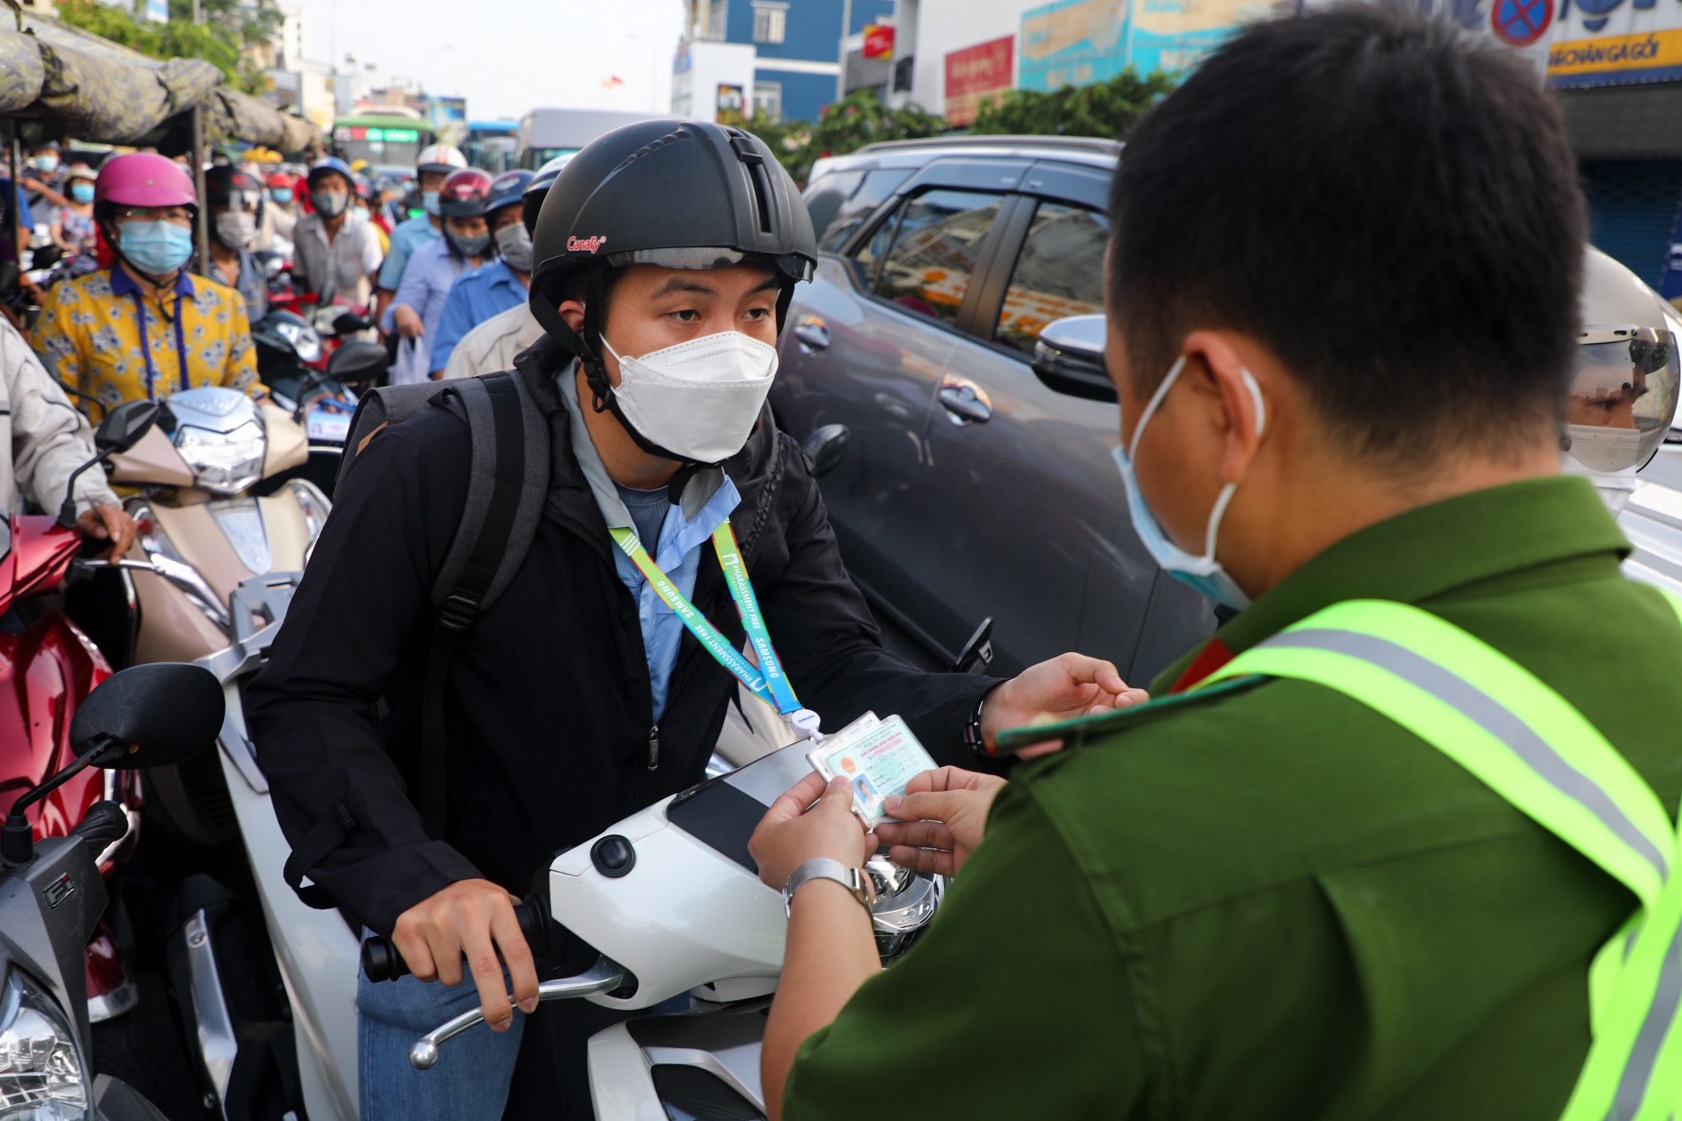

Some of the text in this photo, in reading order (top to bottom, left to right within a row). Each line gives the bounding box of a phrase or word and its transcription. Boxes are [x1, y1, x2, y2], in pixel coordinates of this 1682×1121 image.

[657, 580, 695, 618] SAMSUNG
[695, 624, 712, 641] FREE
[749, 613, 761, 630] FREE
[756, 637, 780, 679] SAMSUNG
